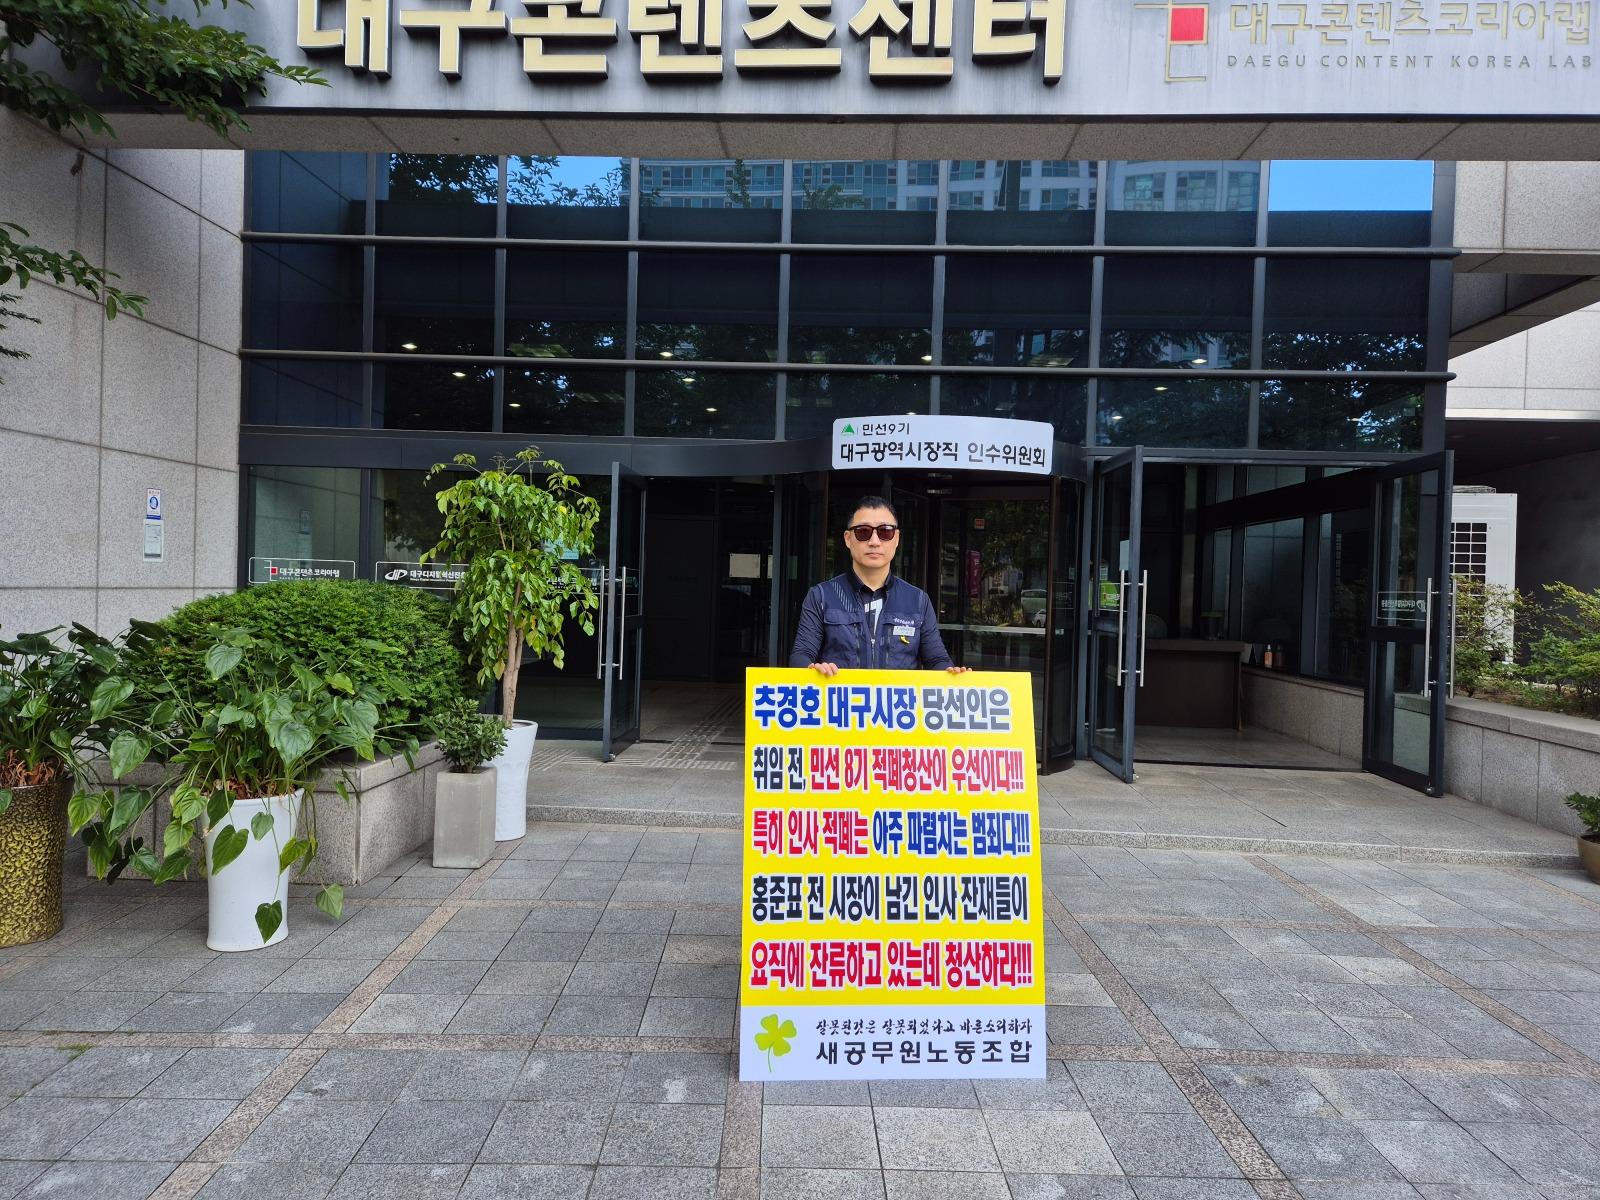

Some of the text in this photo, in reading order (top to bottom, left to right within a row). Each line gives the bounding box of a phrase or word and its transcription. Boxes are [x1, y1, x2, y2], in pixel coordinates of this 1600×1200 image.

[297, 0, 1066, 78] 대구콘텐츠센터
[1229, 0, 1591, 44] 대구콘텐츠코리아랩
[1228, 55, 1592, 68] DAEGU CONTENT KOREA LAB
[863, 423, 909, 436] 민선9기
[841, 442, 1046, 467] 대구광역시장직 인수위원회
[755, 686, 1009, 730] 추경호 대구시장 당선인은
[754, 747, 783, 789] 취임
[811, 748, 839, 790] 민선
[845, 749, 867, 790] 8기
[872, 749, 946, 791] 적폐청산이
[952, 749, 1023, 791] 우선이다!!!
[754, 811, 1029, 855] 특히 인사 적폐는 아주 파렴치는 범죄다!!!
[753, 876, 1027, 921] 홍준표 전 시장이 남긴 인사 잔재들이
[751, 942, 1031, 987] 요직에 잔류하고 있는데 청산하라!!!
[816, 1040, 1032, 1065] 새공무원노동조합
